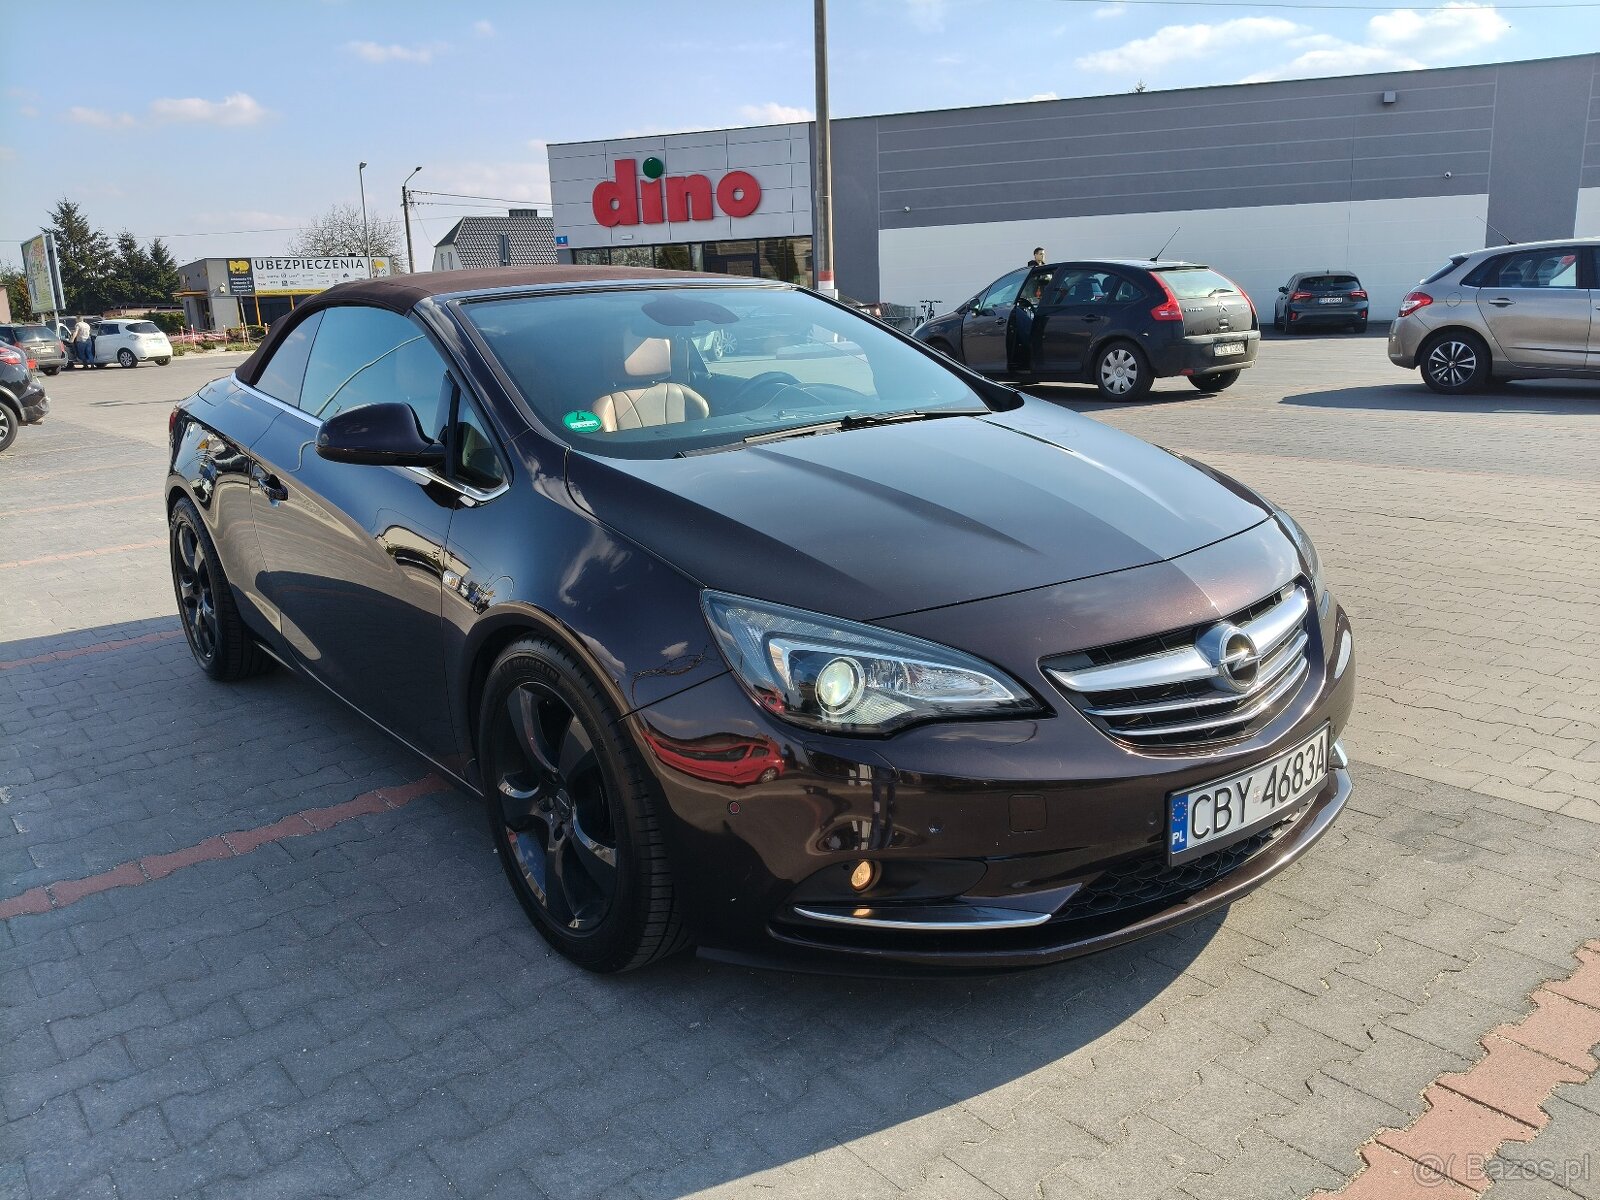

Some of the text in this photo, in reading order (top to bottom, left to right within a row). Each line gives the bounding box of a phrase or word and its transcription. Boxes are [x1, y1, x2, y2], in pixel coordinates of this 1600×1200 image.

[592, 156, 762, 228] dino
[254, 259, 364, 270] UBEZPIECZENIA
[1191, 736, 1326, 840] CBY 4683A
[1172, 831, 1185, 845] PL
